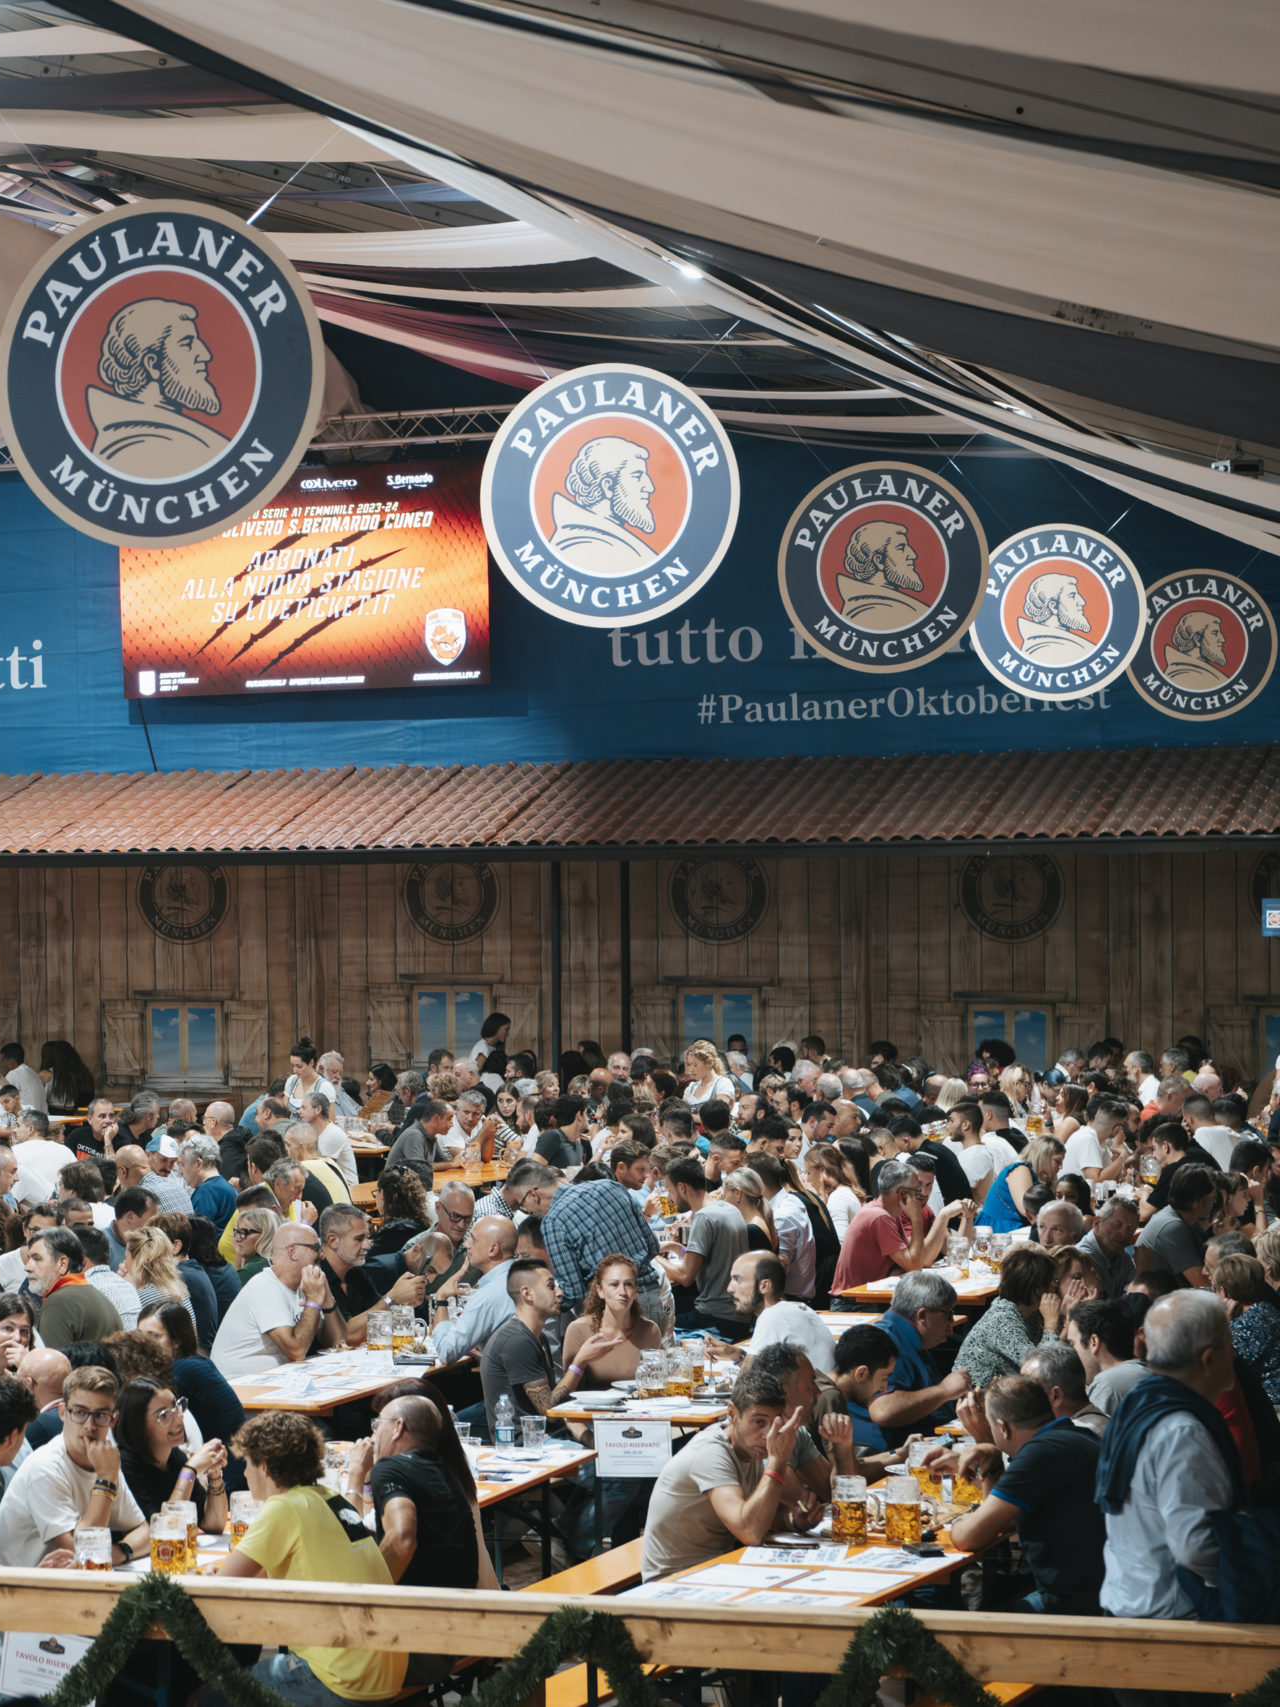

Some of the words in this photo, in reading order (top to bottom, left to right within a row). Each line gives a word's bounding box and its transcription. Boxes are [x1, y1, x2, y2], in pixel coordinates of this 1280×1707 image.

[22, 222, 287, 347] PAULANER
[510, 380, 720, 476] PAULANER
[49, 437, 274, 525] MÜNCHEN
[262, 507, 289, 519] SERIE
[304, 504, 355, 517] FEMMINILE
[356, 501, 399, 514] 2023-24
[288, 514, 381, 534] S.BERNARDO
[384, 511, 434, 529] CUNEO
[794, 474, 965, 551] PAULANER
[247, 546, 356, 572] ABBONATI
[514, 540, 690, 608] MÜNCHEN
[985, 534, 1127, 598] PAULANER
[181, 578, 234, 600] ALLA
[242, 573, 312, 598] NUOVA
[319, 567, 425, 594] STAGIONE
[210, 601, 239, 623] SU
[246, 594, 397, 621] LIVETICKET.IT
[607, 617, 763, 667] tutto
[813, 605, 959, 658] MÜNCHEN
[998, 644, 1121, 688] MÜNCHEN
[697, 685, 1111, 725] #PaulanerOktobest
[1143, 672, 1249, 710] MÜNCHEN
[16, 1651, 45, 1664] TAVOLO
[46, 1658, 74, 1671] RISERV
